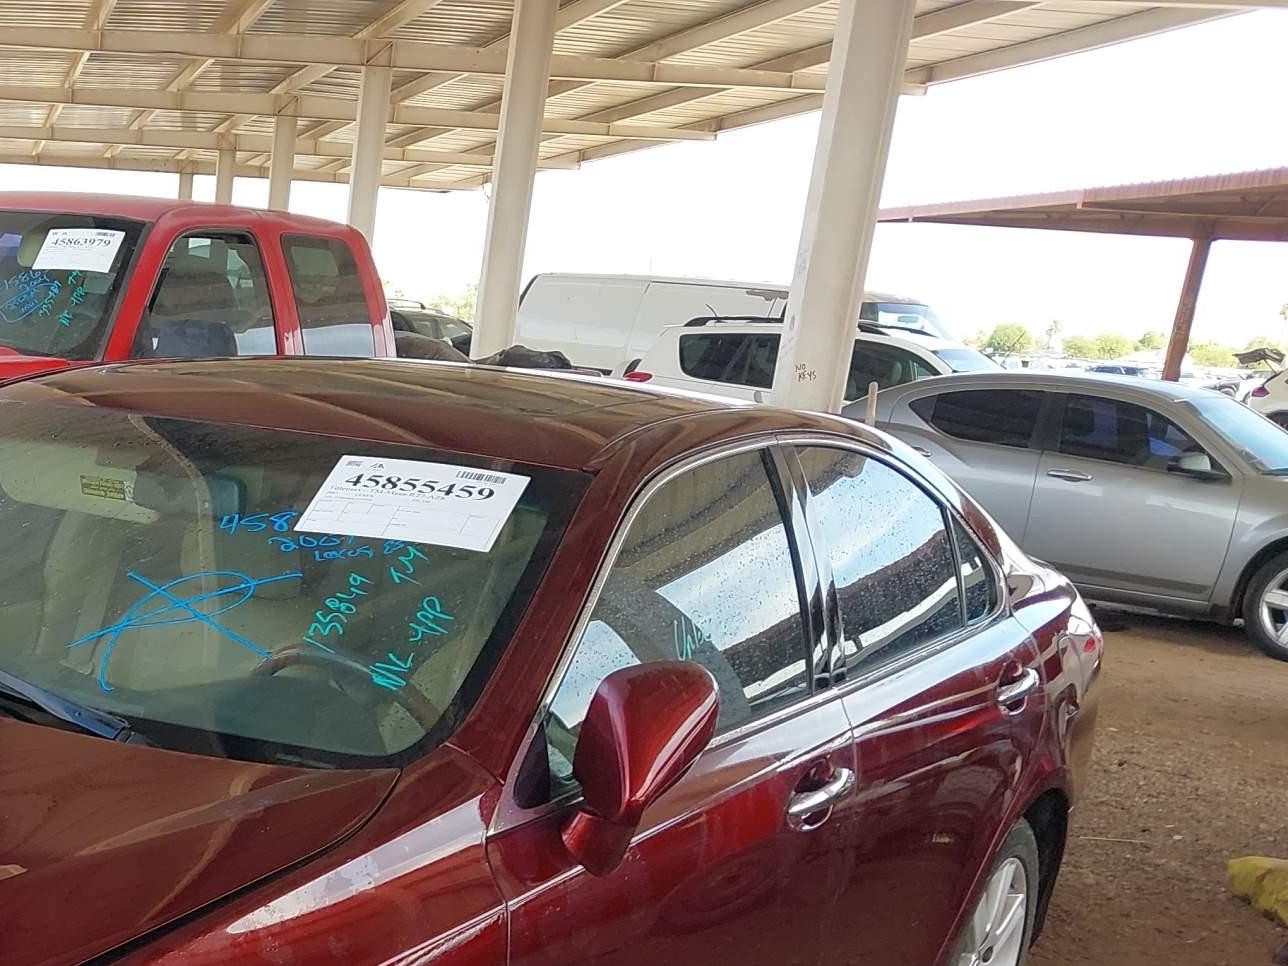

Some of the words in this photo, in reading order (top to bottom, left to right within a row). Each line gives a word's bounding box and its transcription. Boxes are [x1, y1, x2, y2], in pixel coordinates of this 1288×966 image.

[795, 363, 806, 372] NO
[798, 370, 817, 382] KEYS
[345, 473, 495, 501] 45855459
[219, 511, 298, 534] 458
